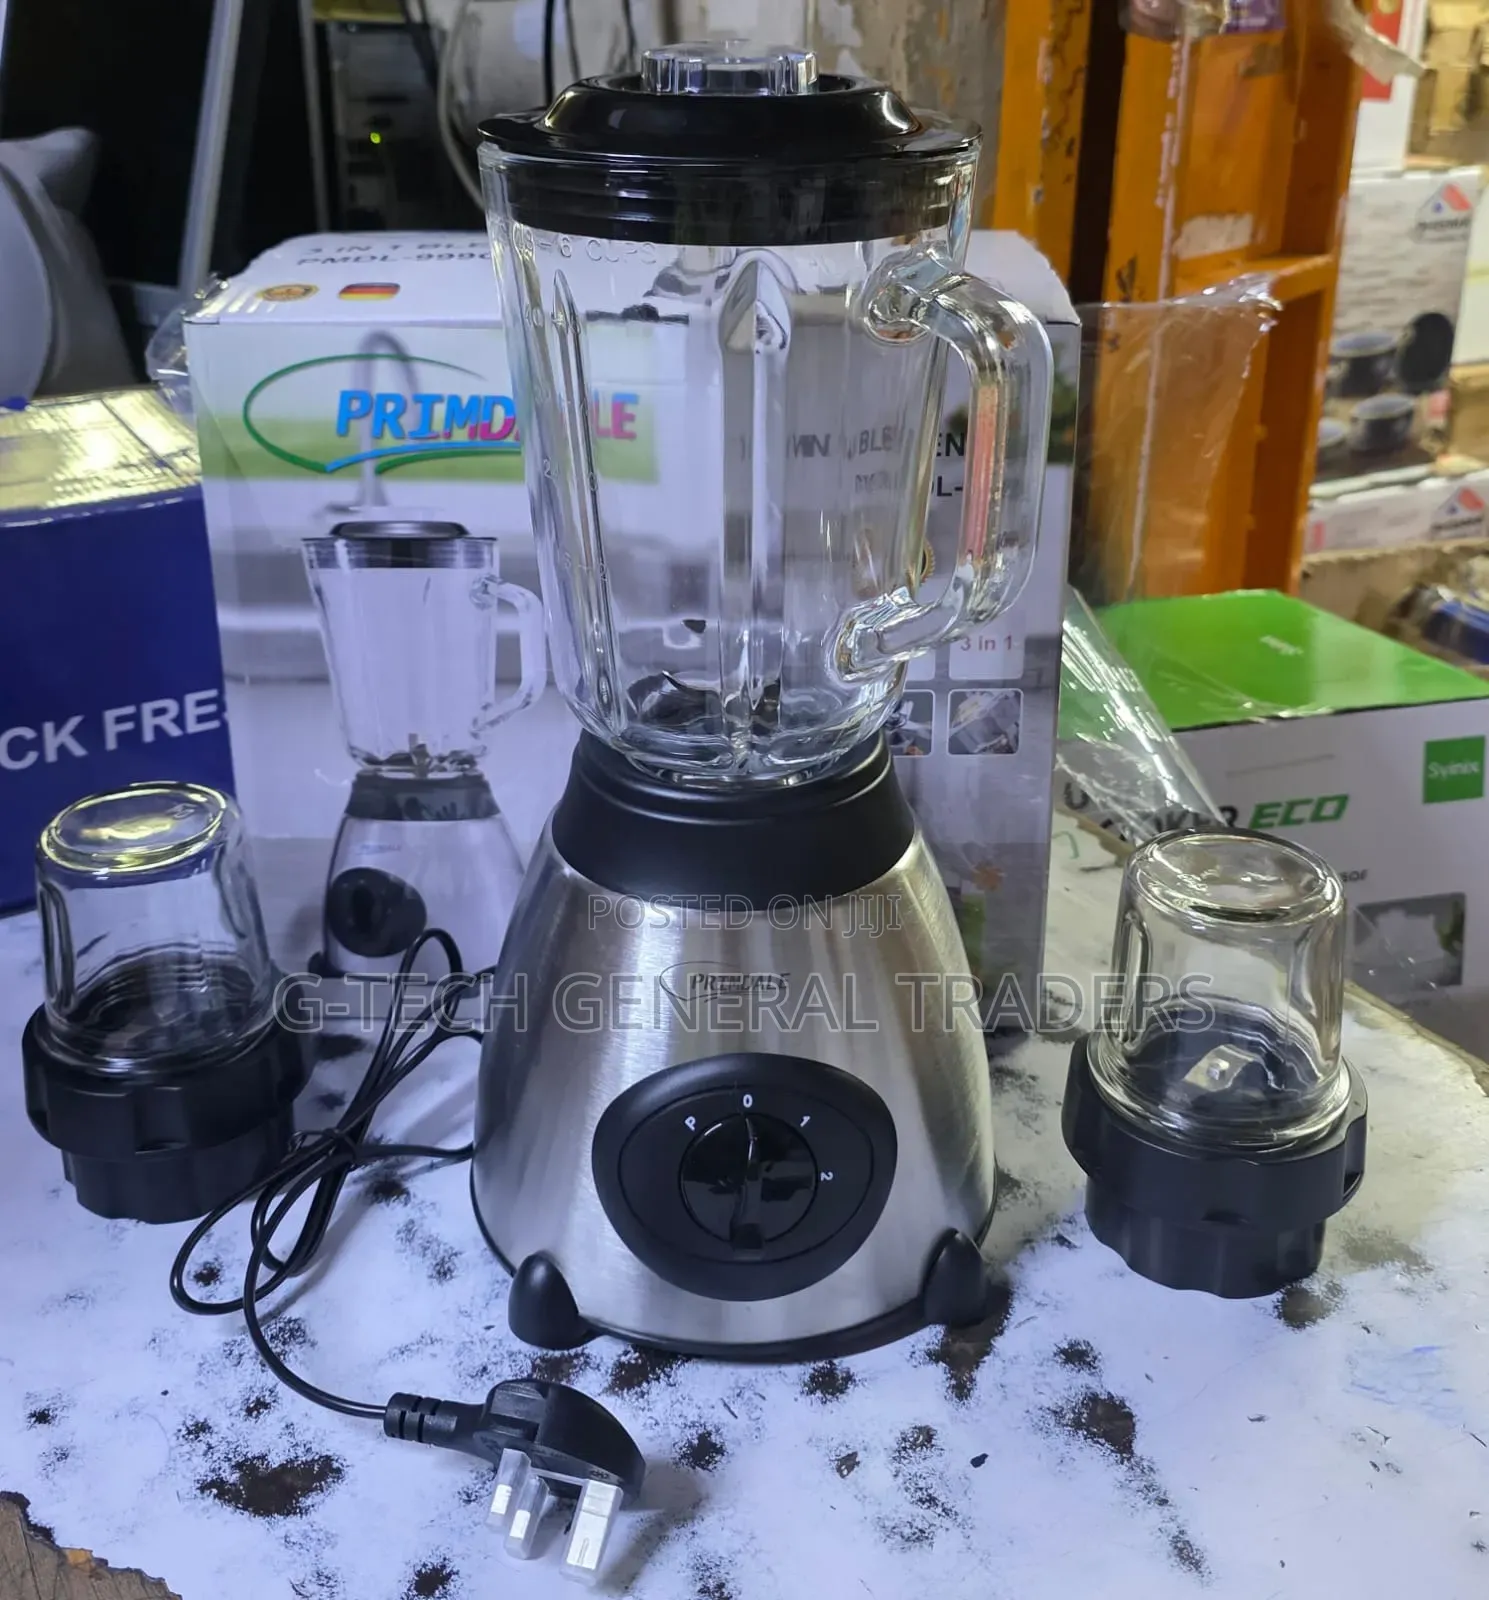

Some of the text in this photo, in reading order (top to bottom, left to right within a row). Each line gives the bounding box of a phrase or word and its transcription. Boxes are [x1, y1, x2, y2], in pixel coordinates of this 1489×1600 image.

[335, 389, 640, 441] PRIMDLE
[960, 636, 972, 651] 3
[1003, 634, 1013, 651] 1
[0, 688, 228, 770] CK FRE
[1250, 794, 1349, 830] ECO
[691, 972, 791, 991] PRIMDALE
[684, 1115, 697, 1131] P
[799, 1115, 811, 1127] 1
[820, 1171, 834, 1181] 2
